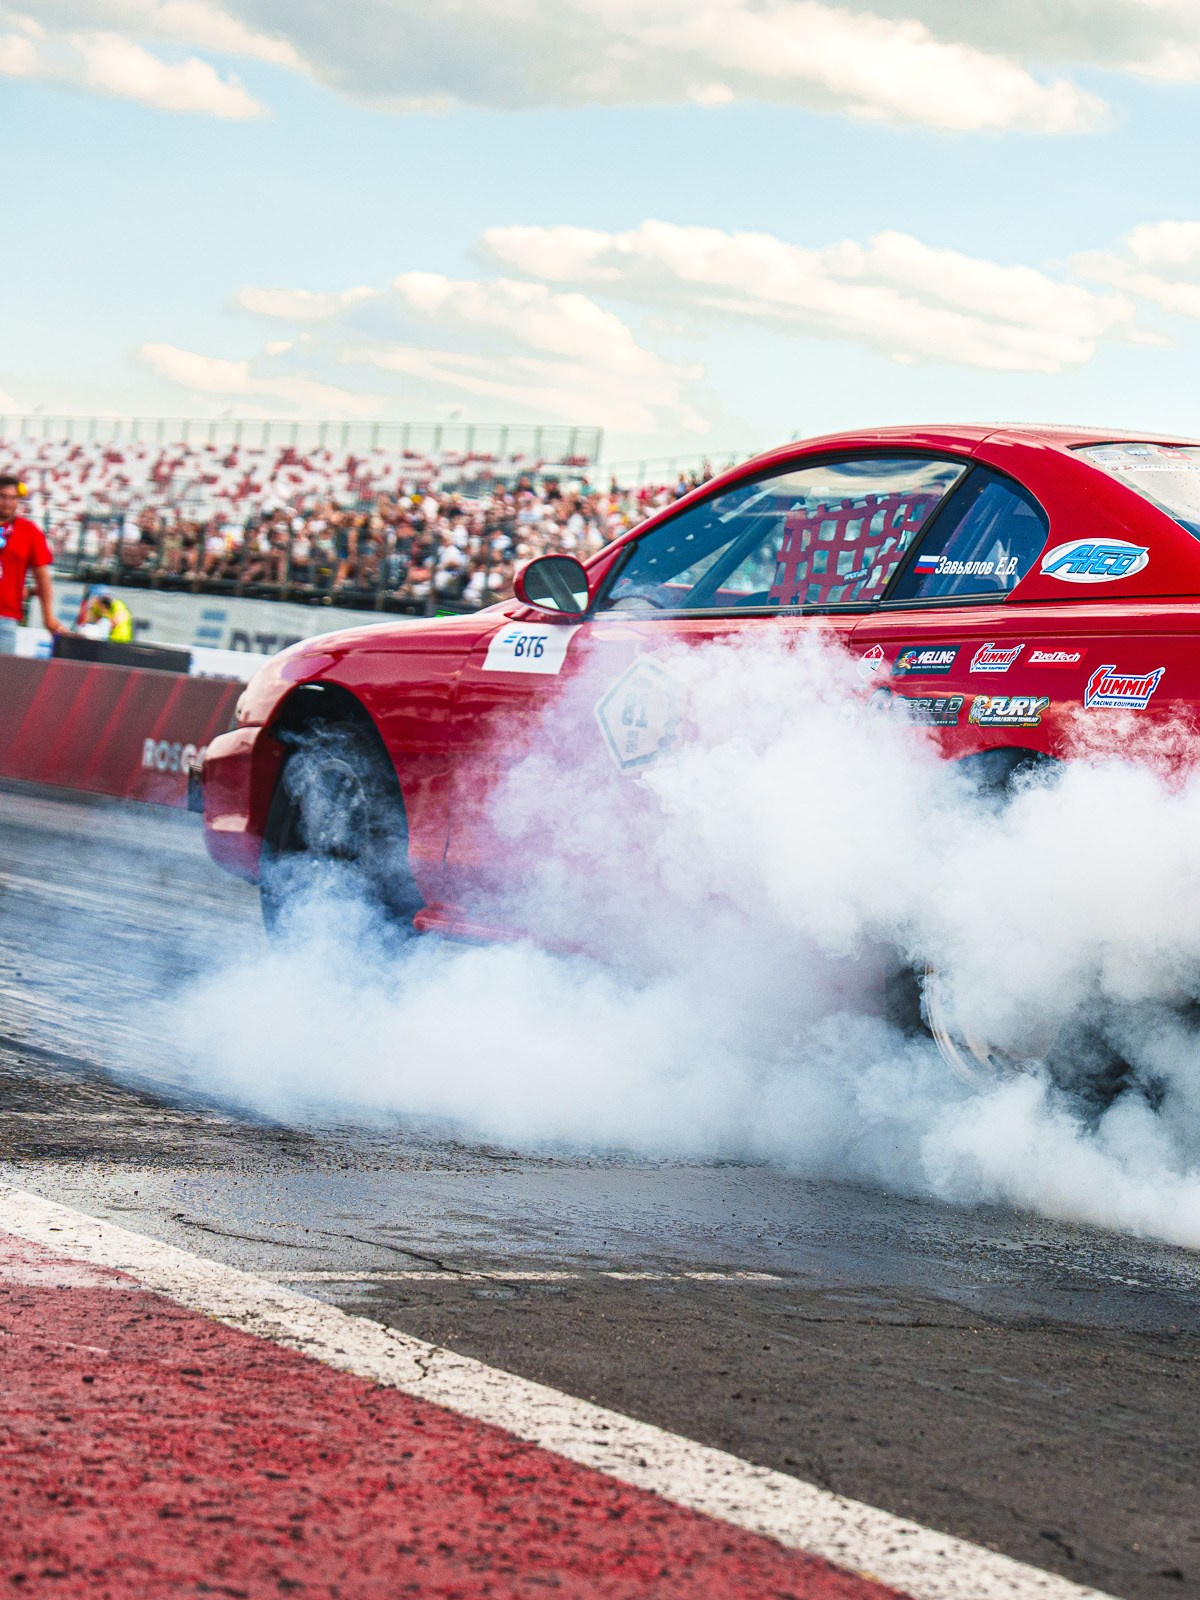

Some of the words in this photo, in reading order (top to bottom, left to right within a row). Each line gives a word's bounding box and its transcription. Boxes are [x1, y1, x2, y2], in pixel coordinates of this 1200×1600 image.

[935, 556, 993, 575] Завьялов
[994, 558, 1018, 576] Е.В.
[1043, 544, 1146, 575] AFCO
[514, 636, 547, 658] ВТБ
[1028, 651, 1081, 662] FuelTech
[985, 697, 1048, 716] FURY
